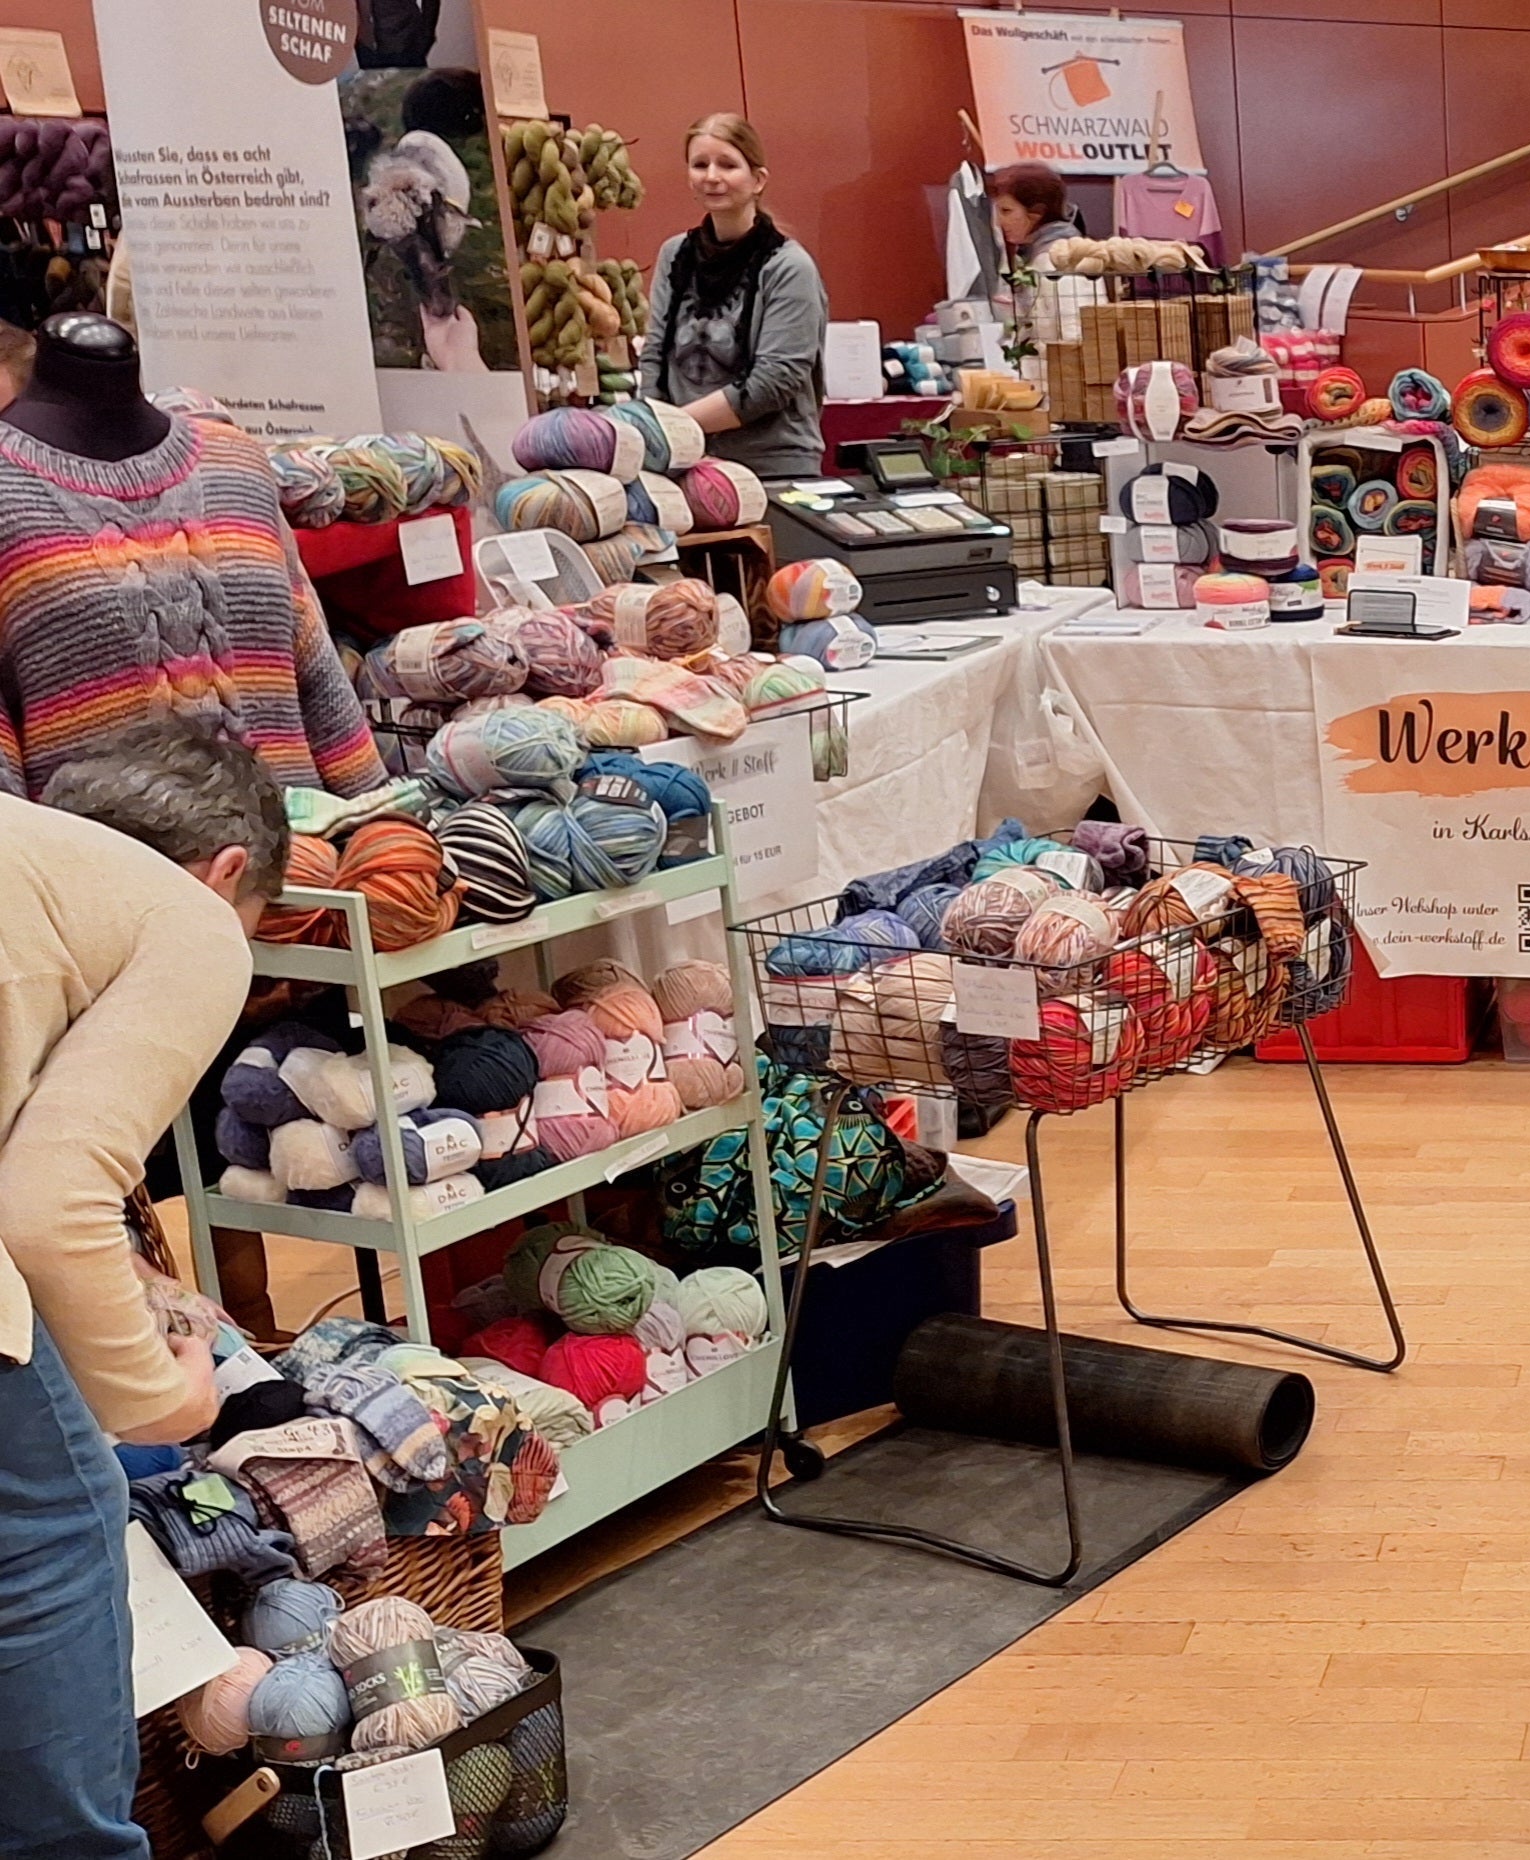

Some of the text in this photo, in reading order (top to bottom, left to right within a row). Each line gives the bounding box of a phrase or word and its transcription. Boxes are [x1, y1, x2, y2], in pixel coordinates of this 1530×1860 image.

[268, 5, 346, 44] SELTENEN
[971, 25, 993, 36] Das
[995, 26, 1069, 41] Wollgeschäft
[281, 33, 332, 63] SCHAF
[158, 147, 183, 164] Sie,
[187, 146, 218, 163] dass
[223, 150, 239, 163] es
[243, 145, 271, 162] acht
[186, 168, 198, 185] in
[201, 165, 272, 186] Österreich
[276, 167, 304, 189] gibt,
[135, 195, 159, 207] vom
[163, 190, 240, 208] Aussterben
[244, 190, 295, 208] bedroht
[300, 191, 330, 208] sind?
[268, 398, 325, 413] Schafrassen
[743, 750, 778, 775] Stoff
[1433, 819, 1455, 840] in
[764, 845, 782, 861] EUR
[1392, 896, 1457, 920] Webshop
[1462, 902, 1499, 916] unter
[435, 1138, 470, 1156] DMC
[437, 1187, 468, 1205] DMC
[355, 1672, 387, 1696] SOCKS
